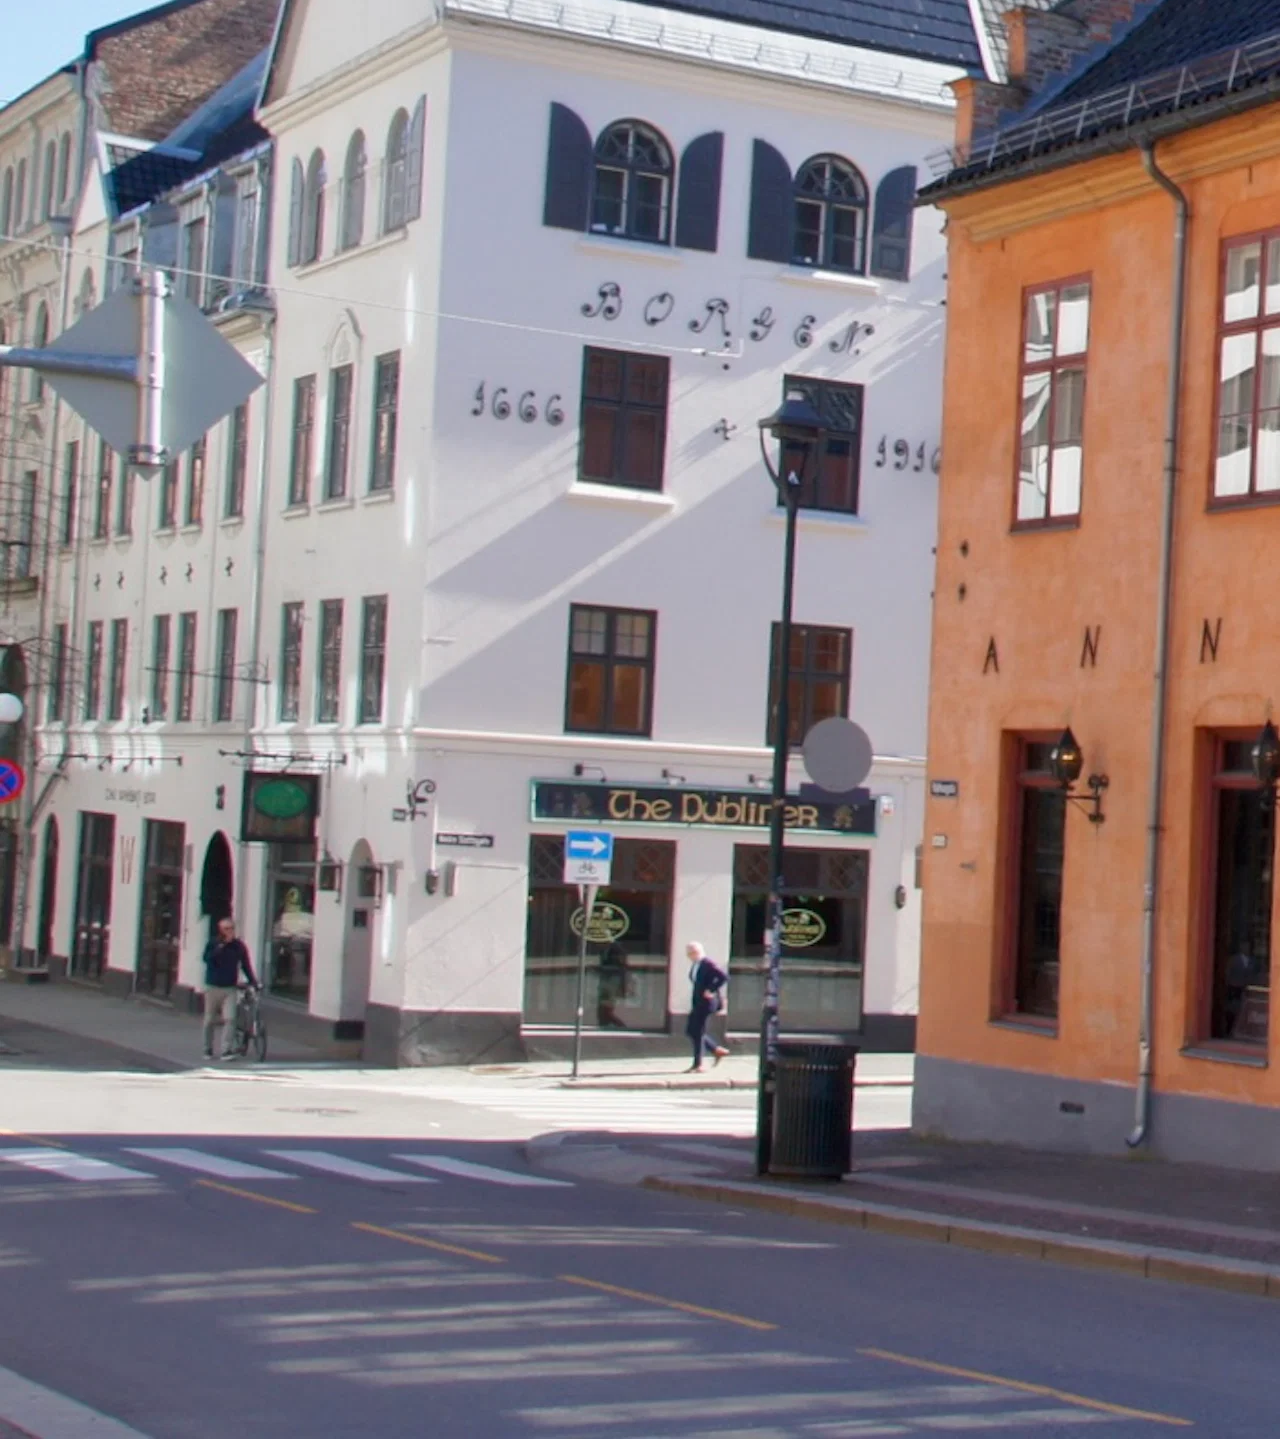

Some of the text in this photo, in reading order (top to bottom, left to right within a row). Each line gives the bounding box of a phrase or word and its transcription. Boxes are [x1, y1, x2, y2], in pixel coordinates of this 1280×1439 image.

[581, 282, 875, 353] BORGEN
[471, 380, 566, 427] 1666
[608, 790, 673, 821] The
